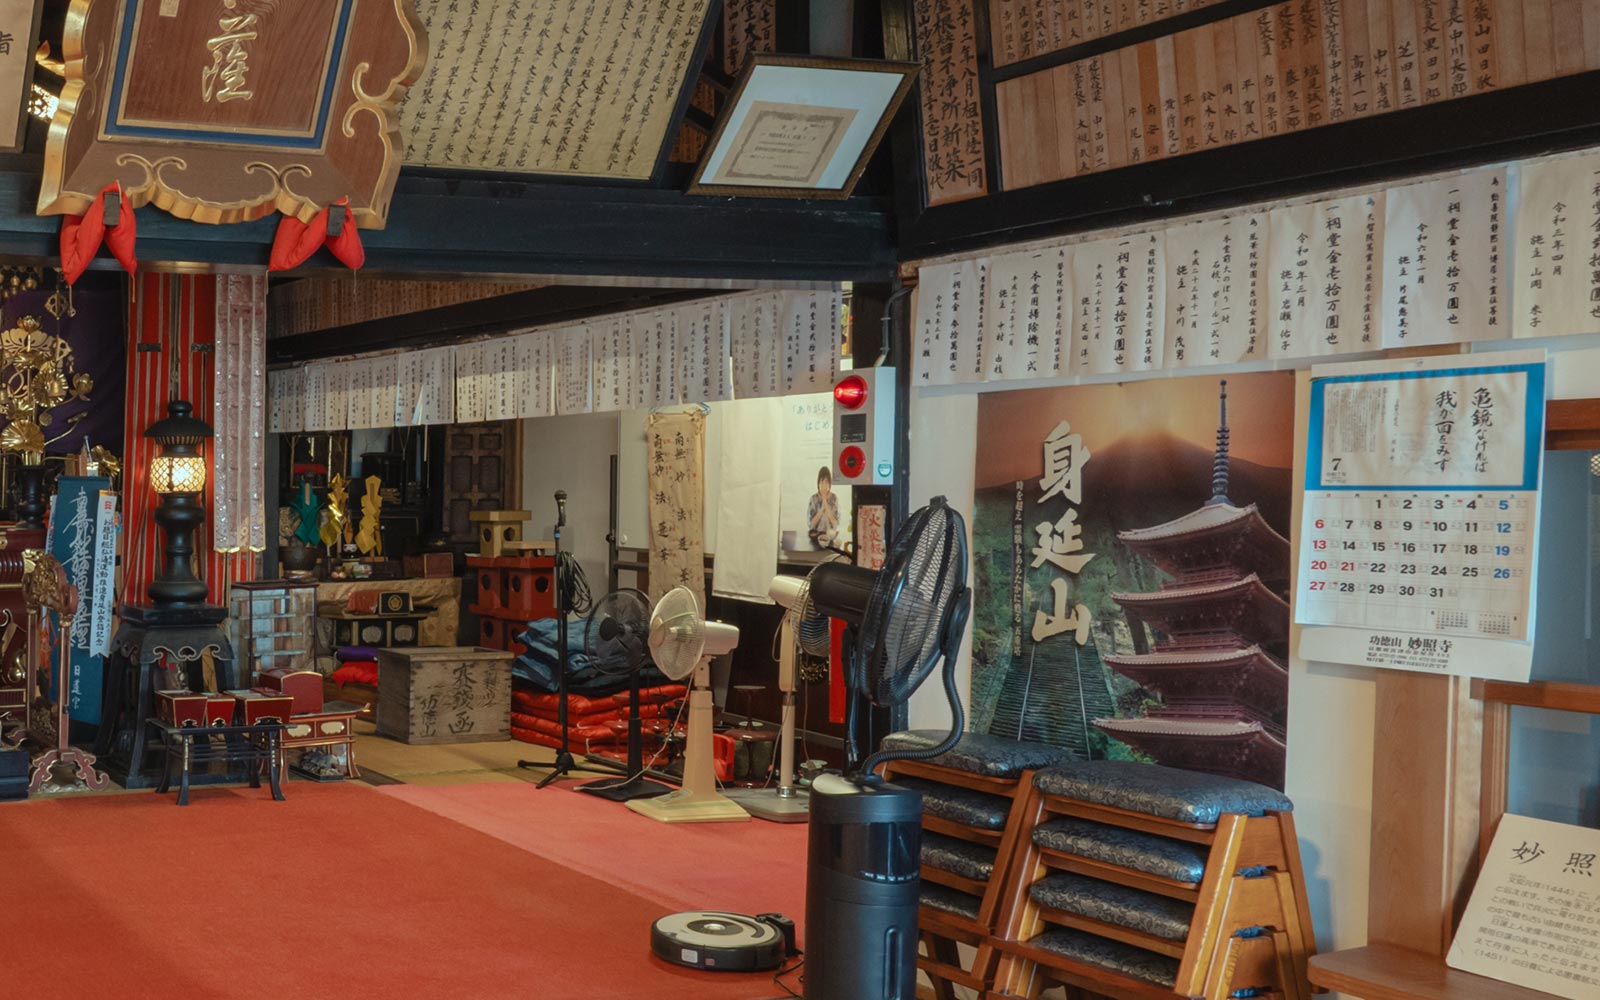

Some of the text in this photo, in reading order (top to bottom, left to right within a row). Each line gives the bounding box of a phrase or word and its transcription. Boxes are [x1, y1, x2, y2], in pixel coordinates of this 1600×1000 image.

[792, 402, 833, 415] 「ありがと
[1331, 457, 1342, 472] 7
[1376, 500, 1508, 510] 1 2 3 4 5
[1030, 419, 1097, 646] 身延山
[1315, 520, 1511, 533] 6 7 8 9 10 11 12
[1313, 540, 1510, 556] 13 14 15 16 17 18 19
[1311, 561, 1510, 579] 20 21 22 23 24 25 26
[1309, 581, 1444, 597] 27 28 29 30 31
[1407, 636, 1454, 653] 妙照寺
